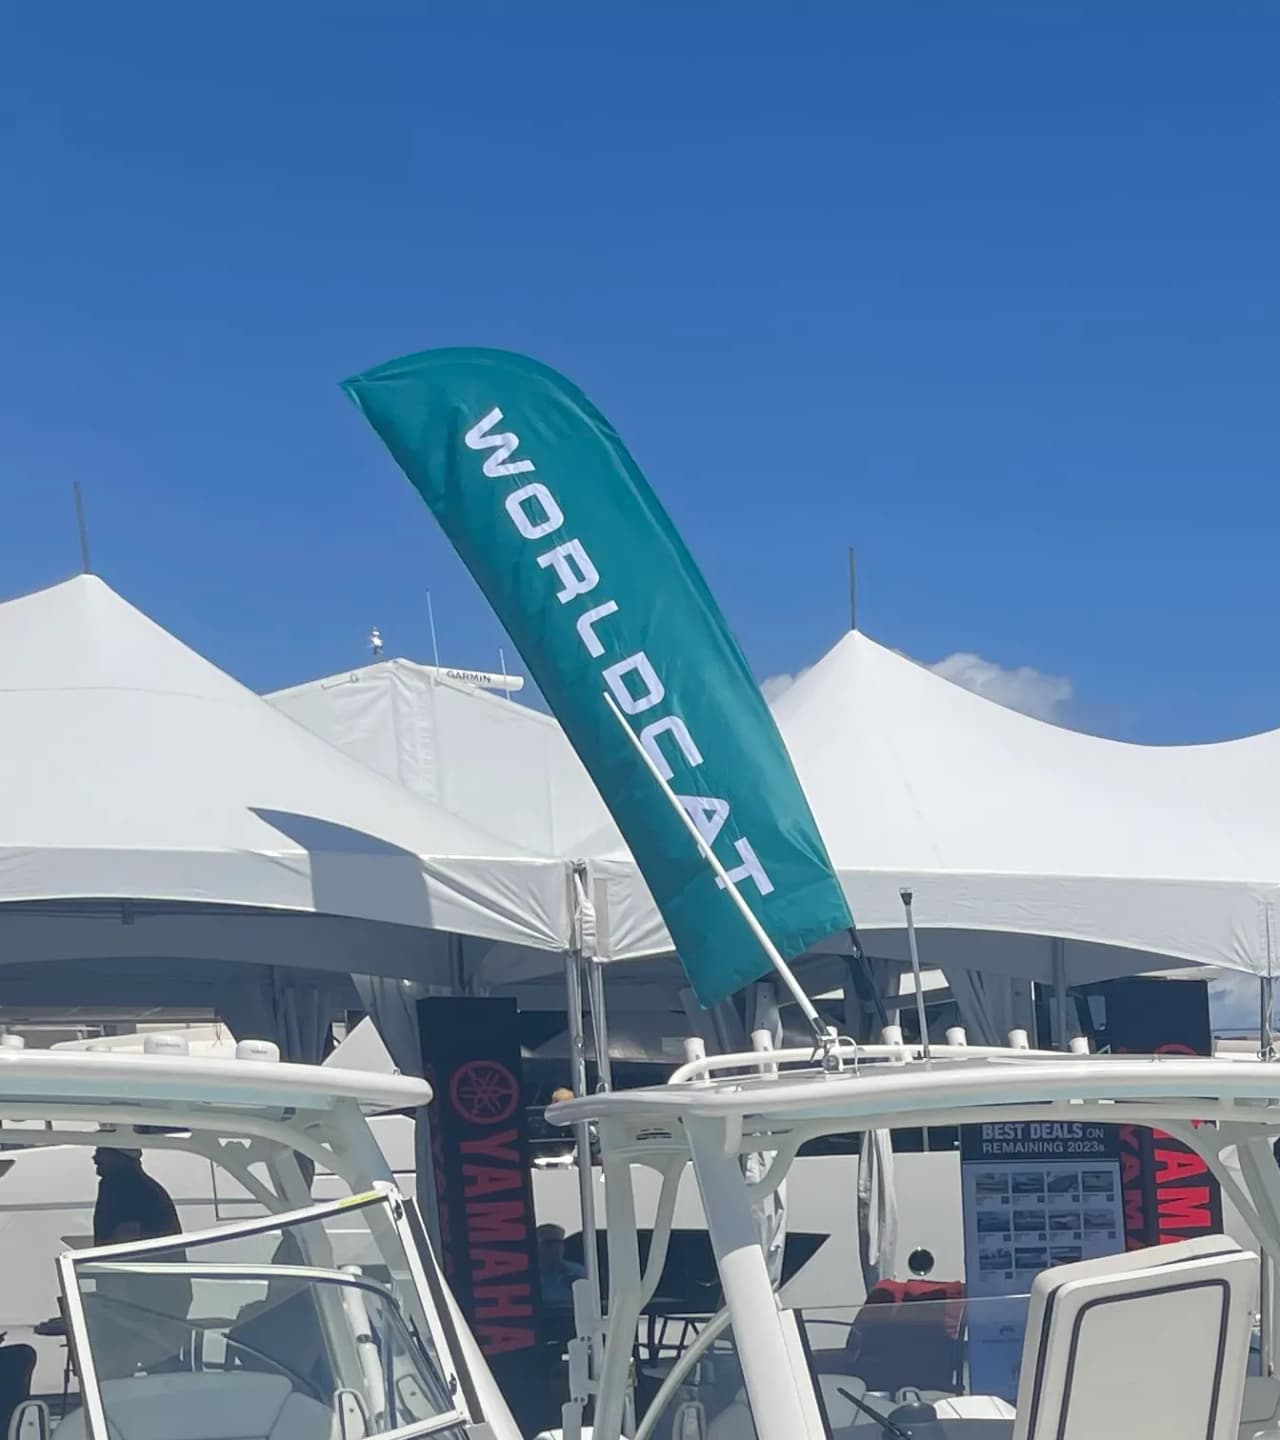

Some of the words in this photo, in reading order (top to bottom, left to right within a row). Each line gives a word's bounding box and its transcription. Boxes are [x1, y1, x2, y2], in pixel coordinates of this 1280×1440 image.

[465, 407, 774, 896] WORLDCAT
[446, 670, 492, 683] GARMIN
[982, 1122, 1024, 1139] BEST
[1030, 1121, 1084, 1139] DEALS
[1086, 1127, 1105, 1139] ON
[982, 1141, 1064, 1154] REMAINING
[459, 1127, 536, 1357] YAMAHA
